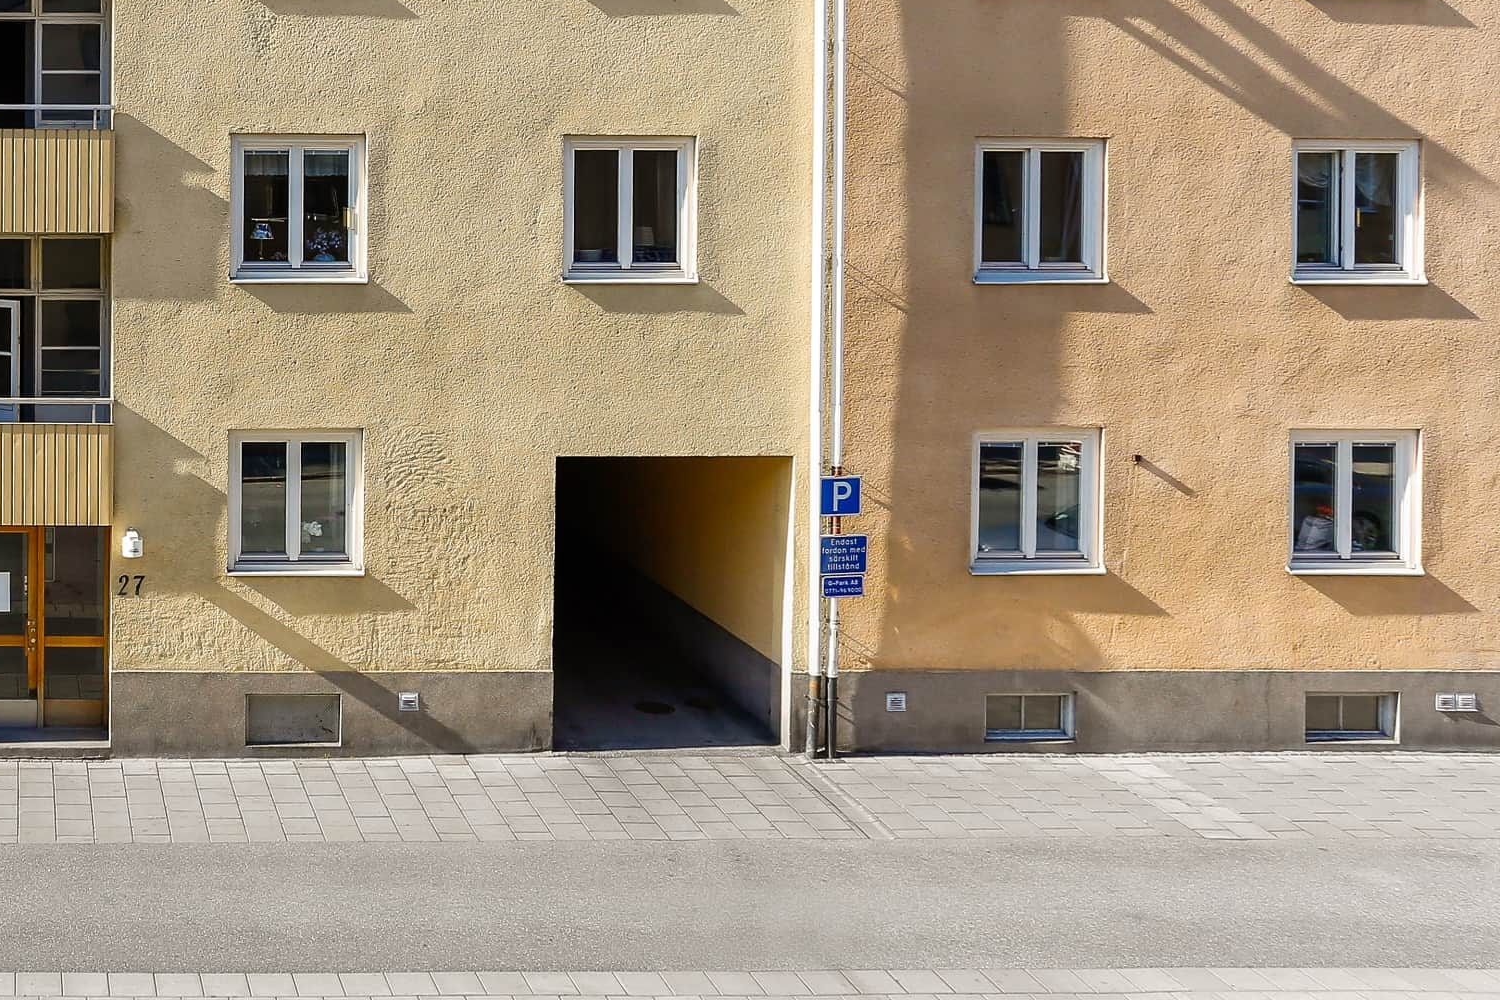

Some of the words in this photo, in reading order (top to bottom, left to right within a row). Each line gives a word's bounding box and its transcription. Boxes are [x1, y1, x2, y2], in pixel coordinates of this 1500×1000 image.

[833, 481, 852, 512] P
[830, 538, 857, 546] Endast
[827, 563, 860, 571] tillstånd
[117, 575, 145, 595] 27
